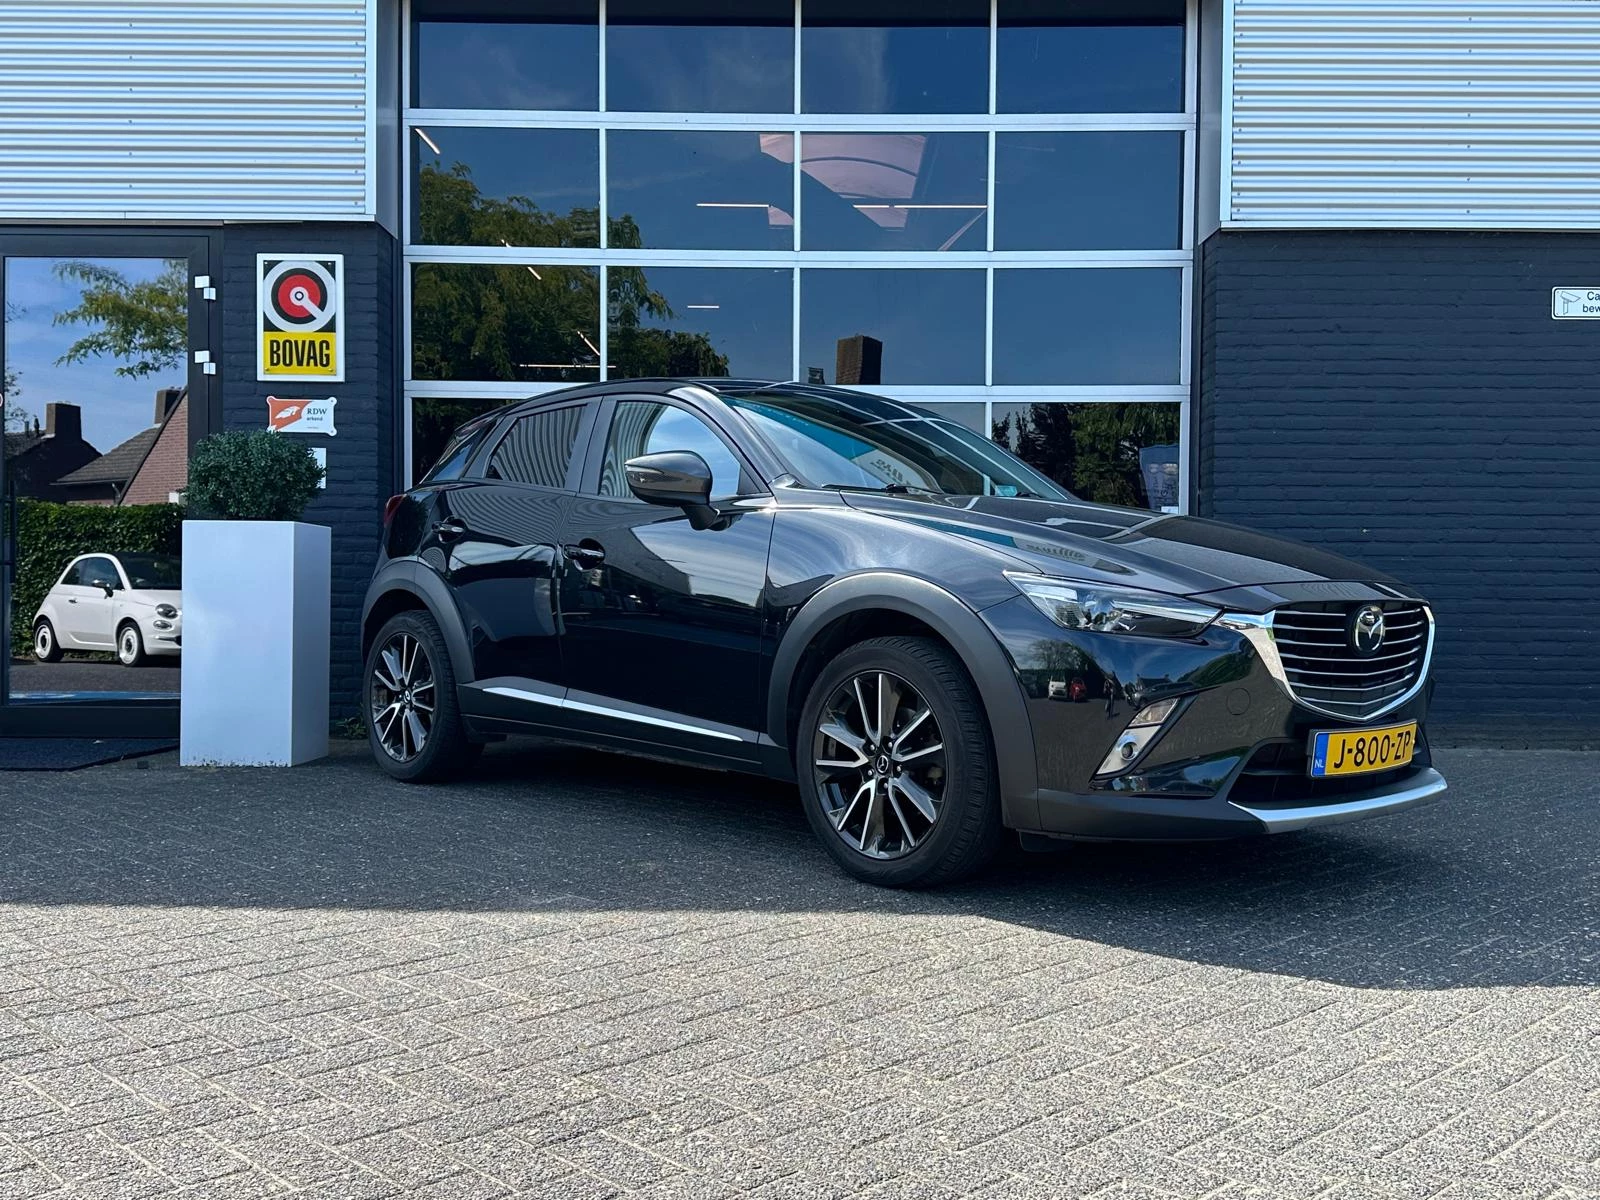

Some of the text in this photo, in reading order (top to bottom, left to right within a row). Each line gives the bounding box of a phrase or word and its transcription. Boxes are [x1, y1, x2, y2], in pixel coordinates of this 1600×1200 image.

[269, 339, 330, 368] BOVAG
[1314, 759, 1325, 768] NL
[1333, 730, 1411, 769] J-800-ZP
